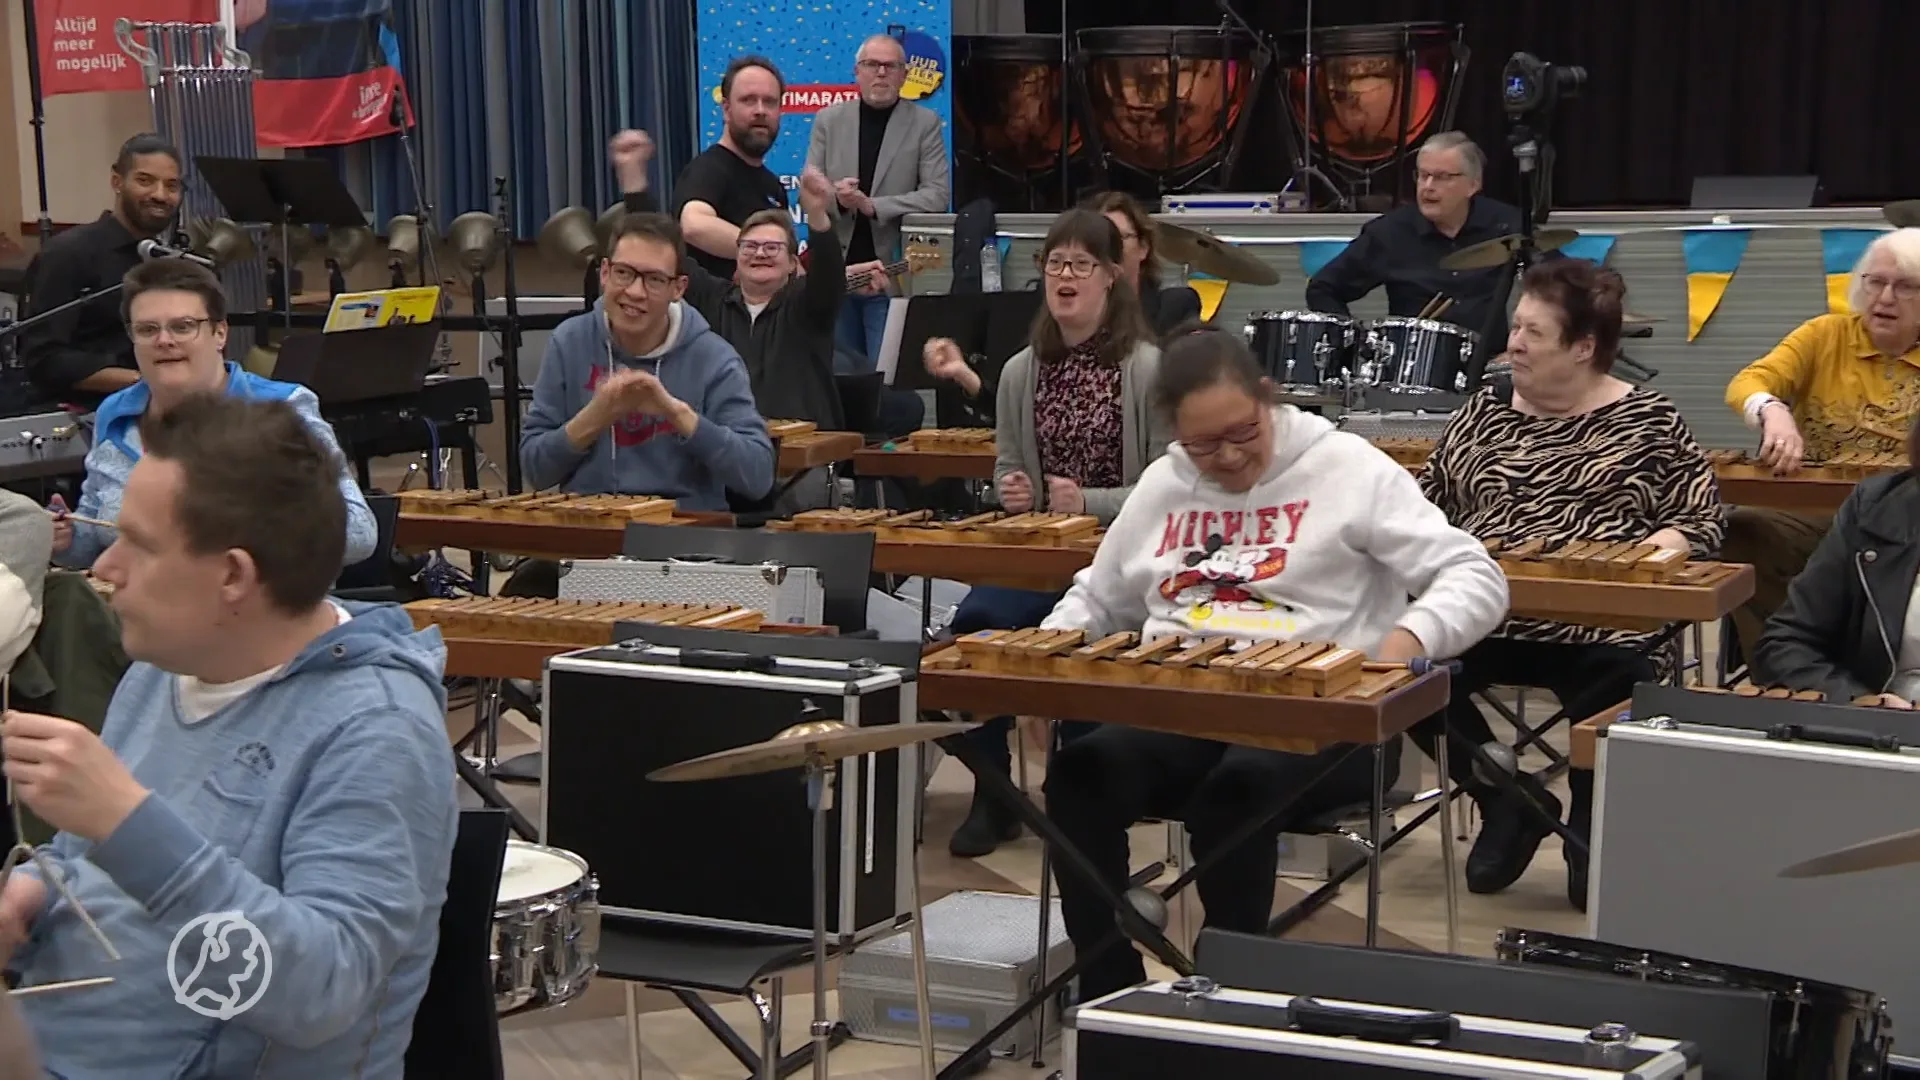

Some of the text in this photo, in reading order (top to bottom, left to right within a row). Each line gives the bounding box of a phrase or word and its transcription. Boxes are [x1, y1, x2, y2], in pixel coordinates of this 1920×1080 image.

[54, 16, 97, 35] Altijd
[53, 39, 95, 52] meer
[56, 53, 127, 73] mogelijk
[1155, 499, 1310, 558] MICKEY
